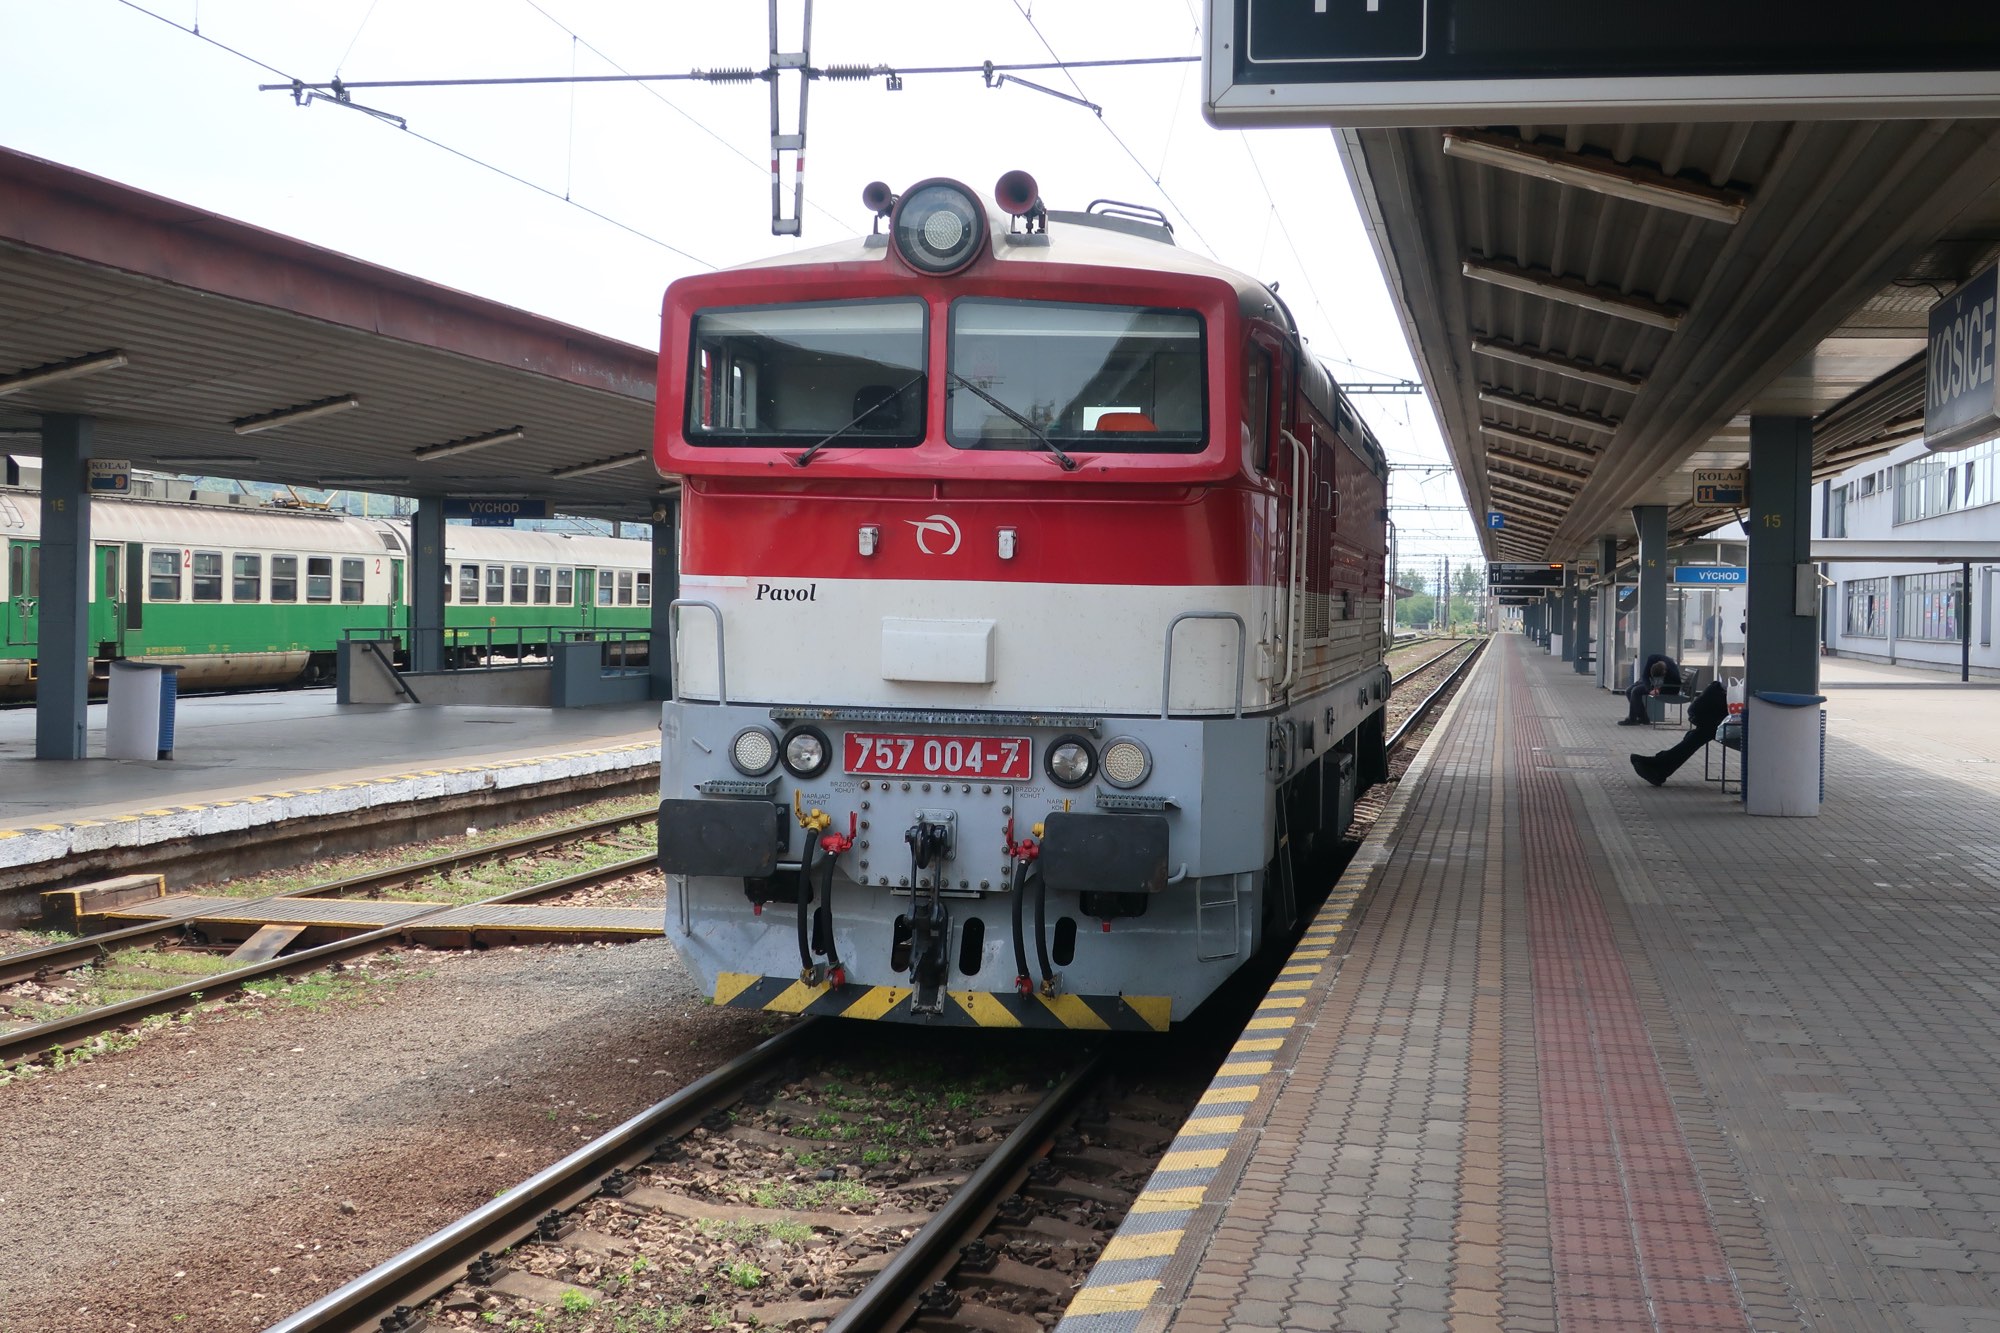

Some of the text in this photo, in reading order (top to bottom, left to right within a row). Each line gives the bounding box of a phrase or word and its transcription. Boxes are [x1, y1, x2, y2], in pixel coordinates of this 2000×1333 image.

[1929, 295, 1994, 410] KOŠICE
[115, 475, 124, 489] 9
[1698, 472, 1742, 481] KOĽAJ
[1699, 487, 1714, 501] 11
[469, 501, 519, 513] VÝCHOD
[1491, 515, 1500, 526] F
[1763, 514, 1782, 528] 15
[184, 549, 191, 568] 2
[375, 558, 381, 575] 2
[1492, 572, 1499, 582] 11
[1699, 570, 1740, 581] VÝCHOD
[755, 583, 817, 602] Pavol
[855, 737, 1020, 774] 757 004-7
